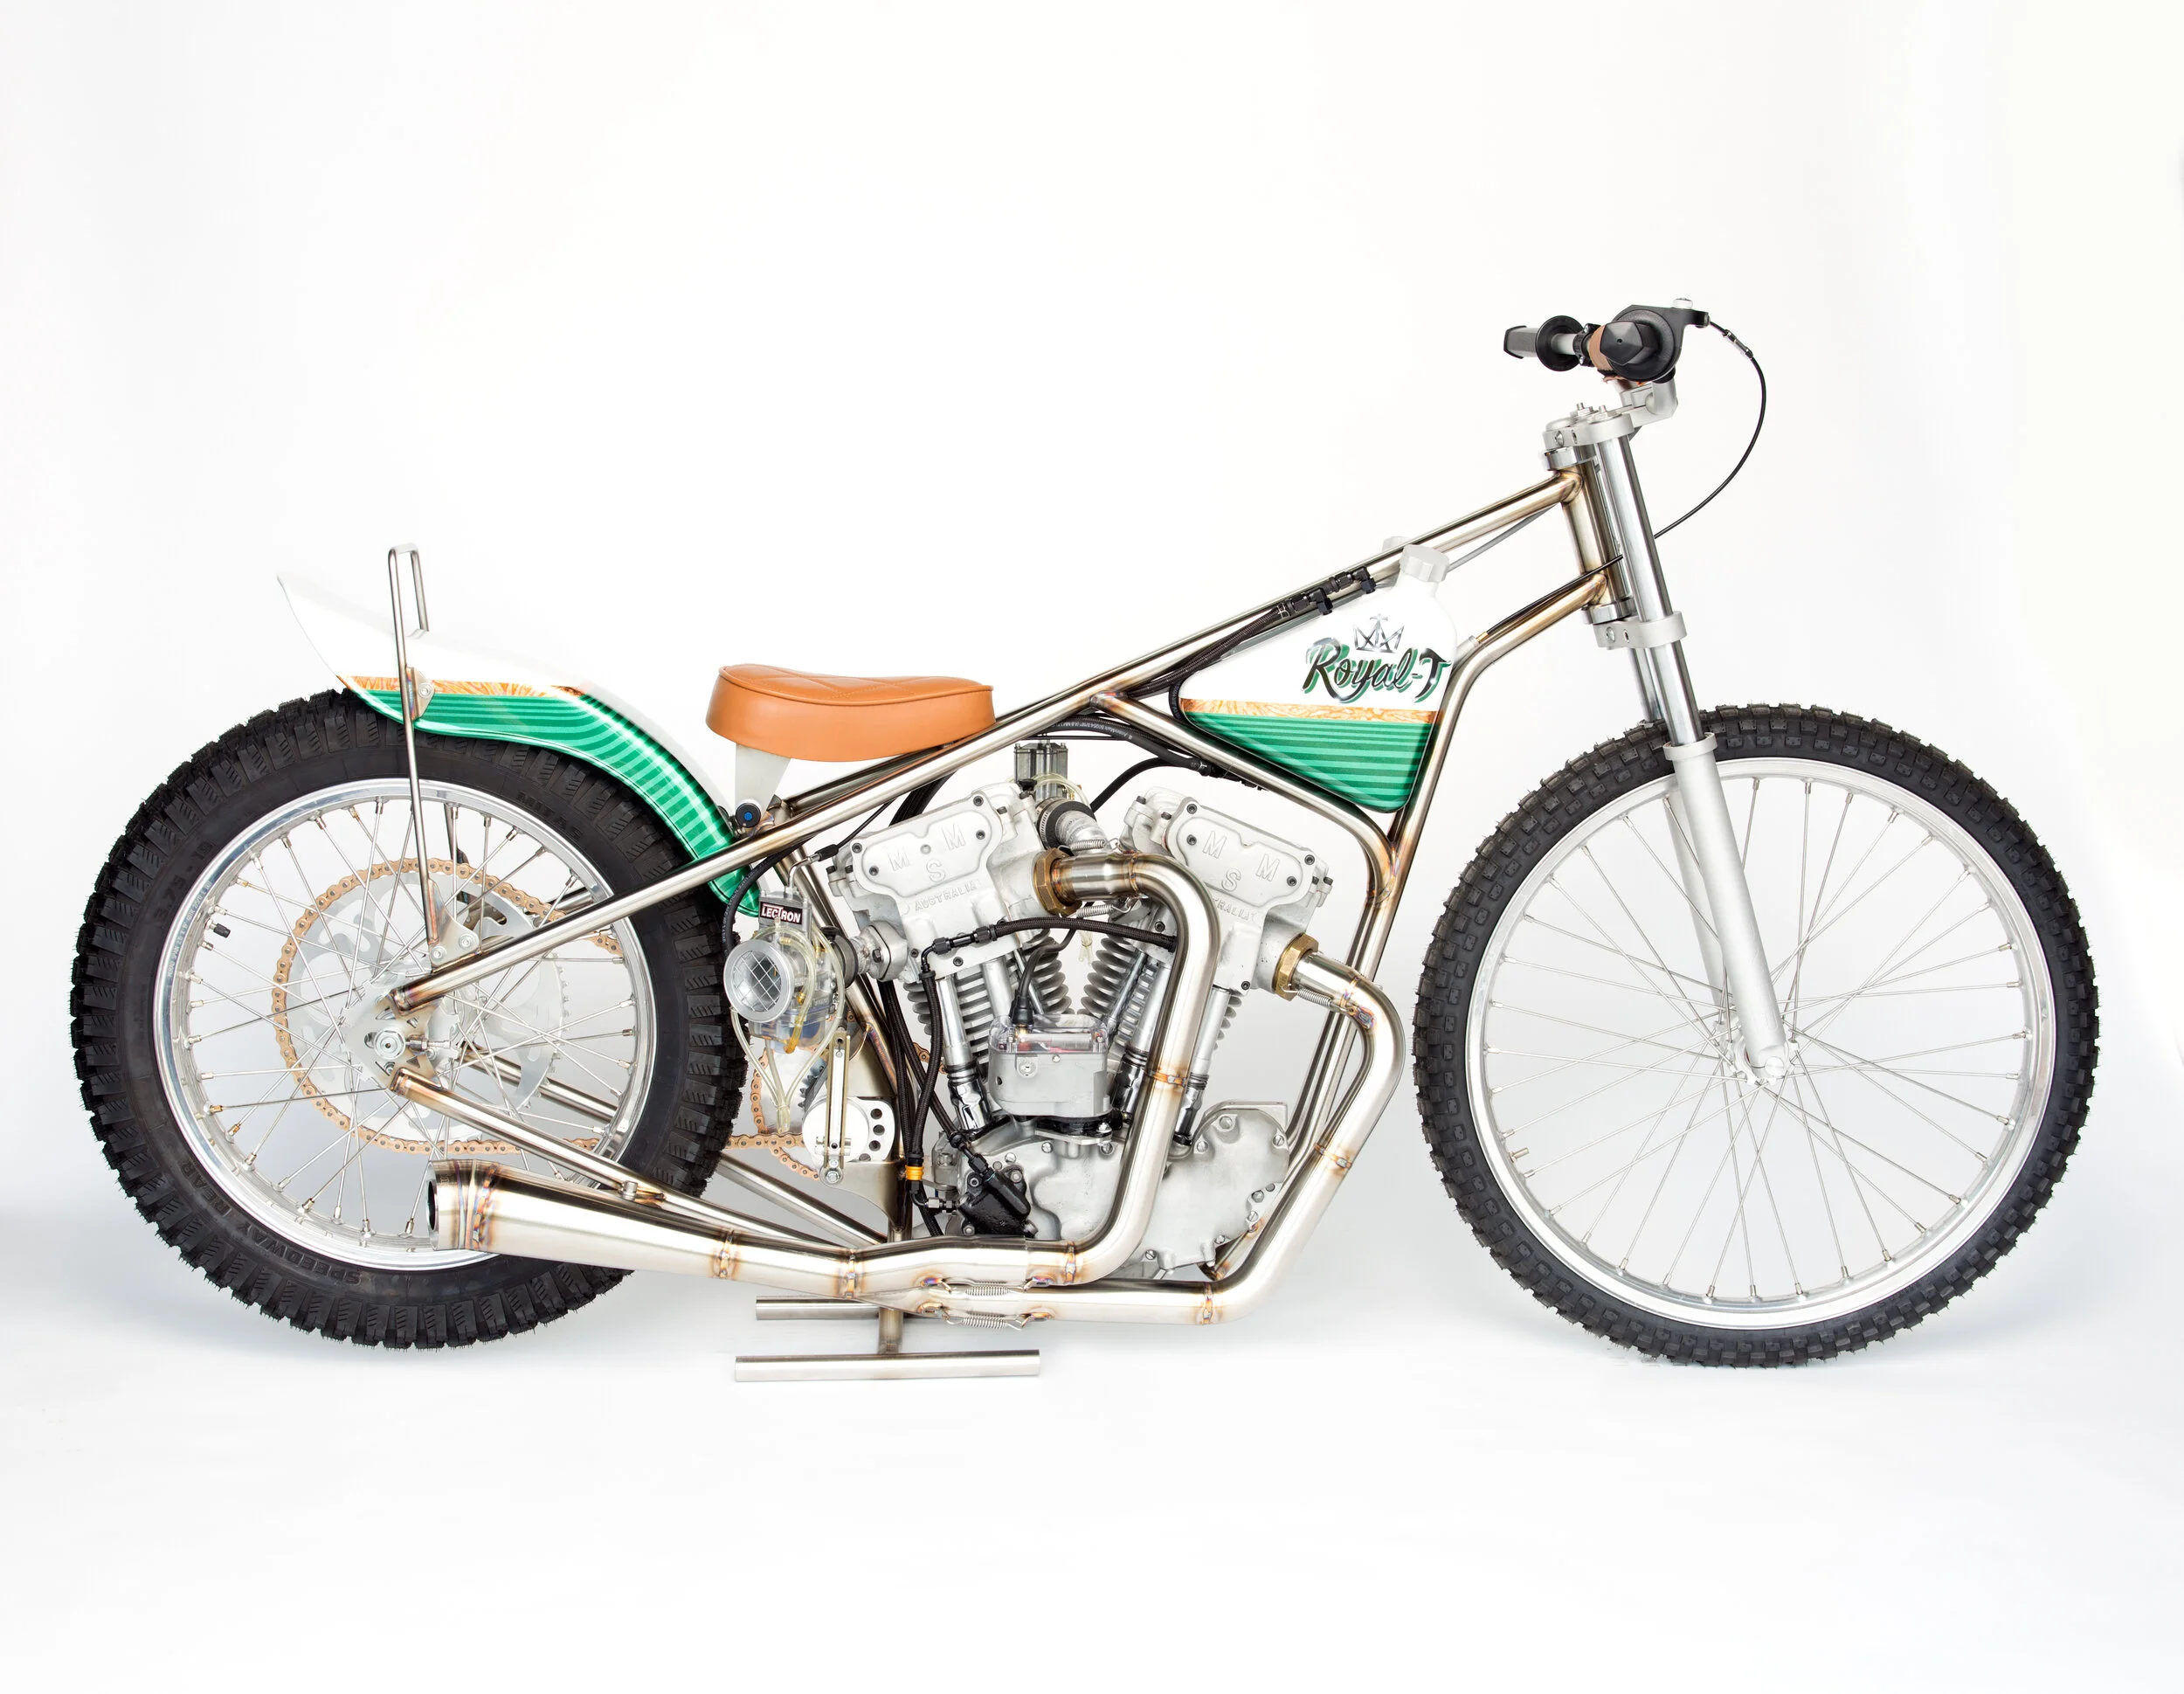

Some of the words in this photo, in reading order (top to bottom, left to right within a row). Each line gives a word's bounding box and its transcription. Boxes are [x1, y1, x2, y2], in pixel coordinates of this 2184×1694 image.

[1302, 637, 1452, 704] Royal-T
[888, 846, 909, 871] M
[942, 822, 966, 850] M
[926, 860, 946, 882] S
[1202, 831, 1227, 859] M
[1255, 854, 1281, 882] M
[915, 880, 978, 912] AUSTRALIA
[1221, 868, 1241, 892] S
[761, 903, 801, 923] LECTRON
[180, 1161, 231, 1217] REAR
[235, 1220, 361, 1287] SPEEDWAY
